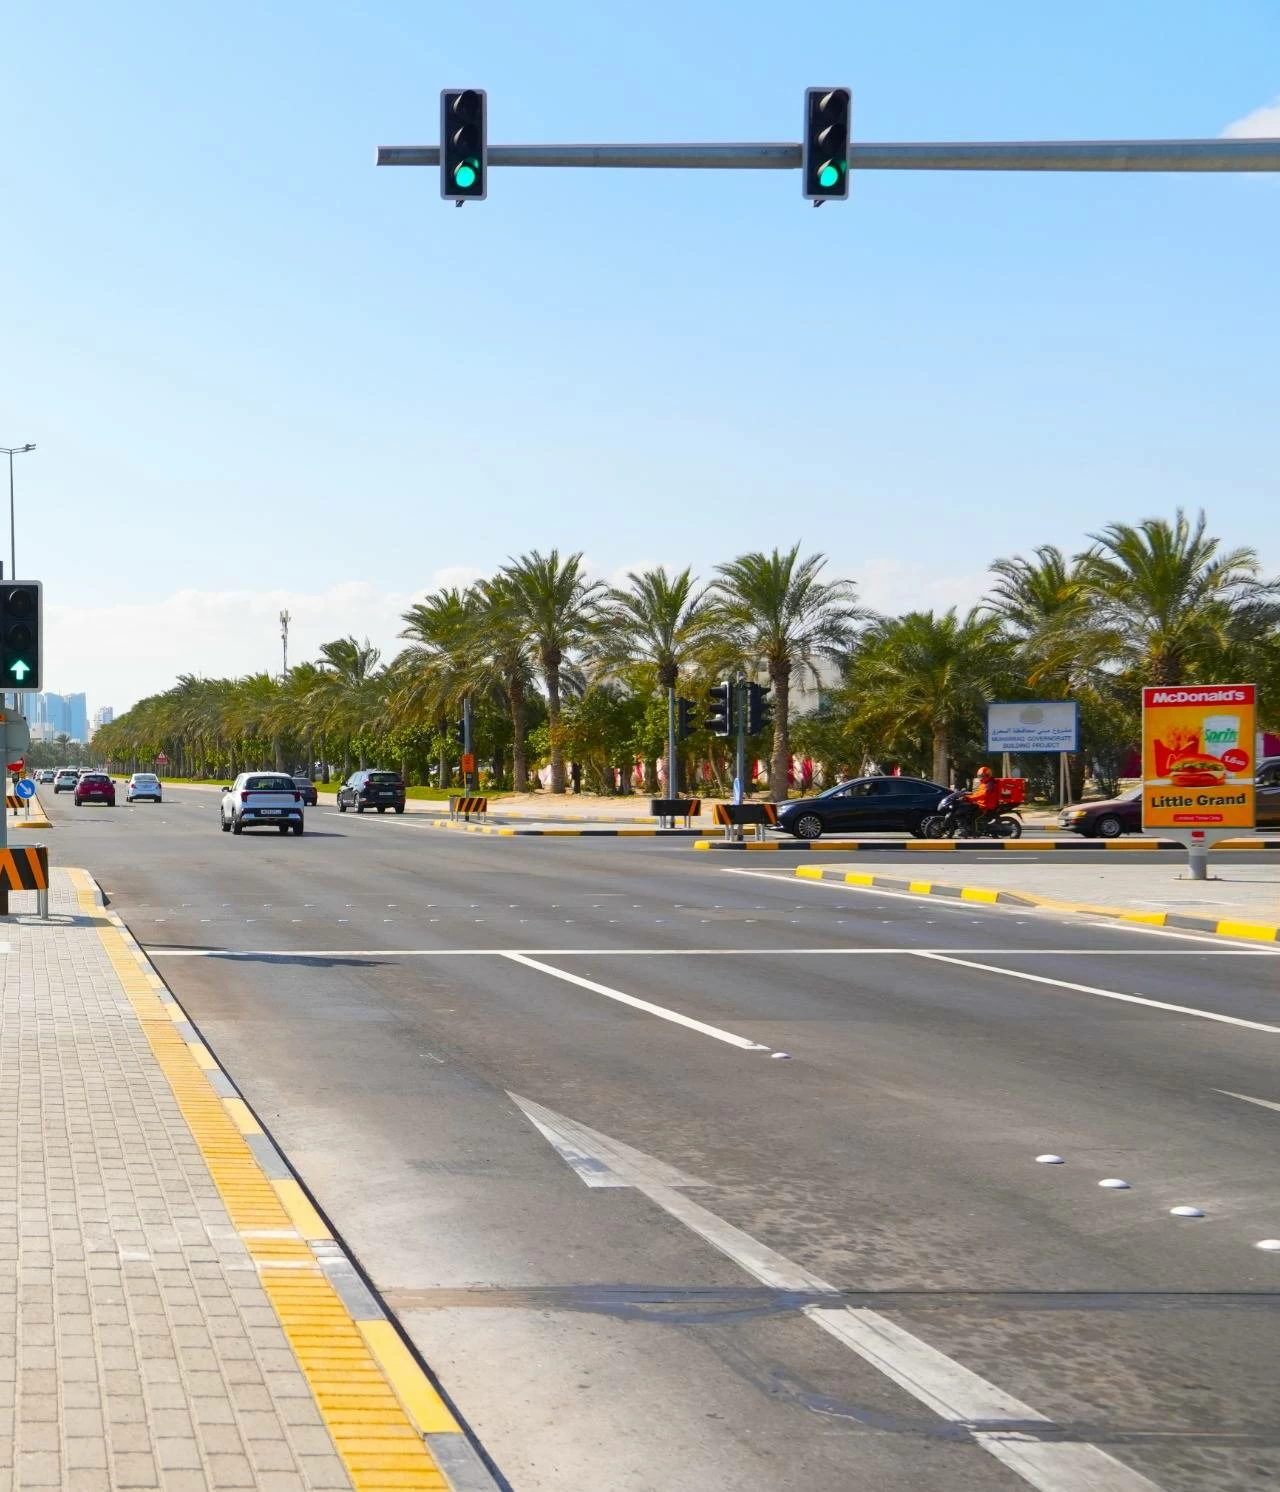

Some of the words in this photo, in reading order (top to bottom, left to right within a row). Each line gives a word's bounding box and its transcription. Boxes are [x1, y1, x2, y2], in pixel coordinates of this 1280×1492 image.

[1152, 690, 1245, 704] McDonald's
[1151, 795, 1193, 808] Little
[1196, 793, 1246, 806] Grand
